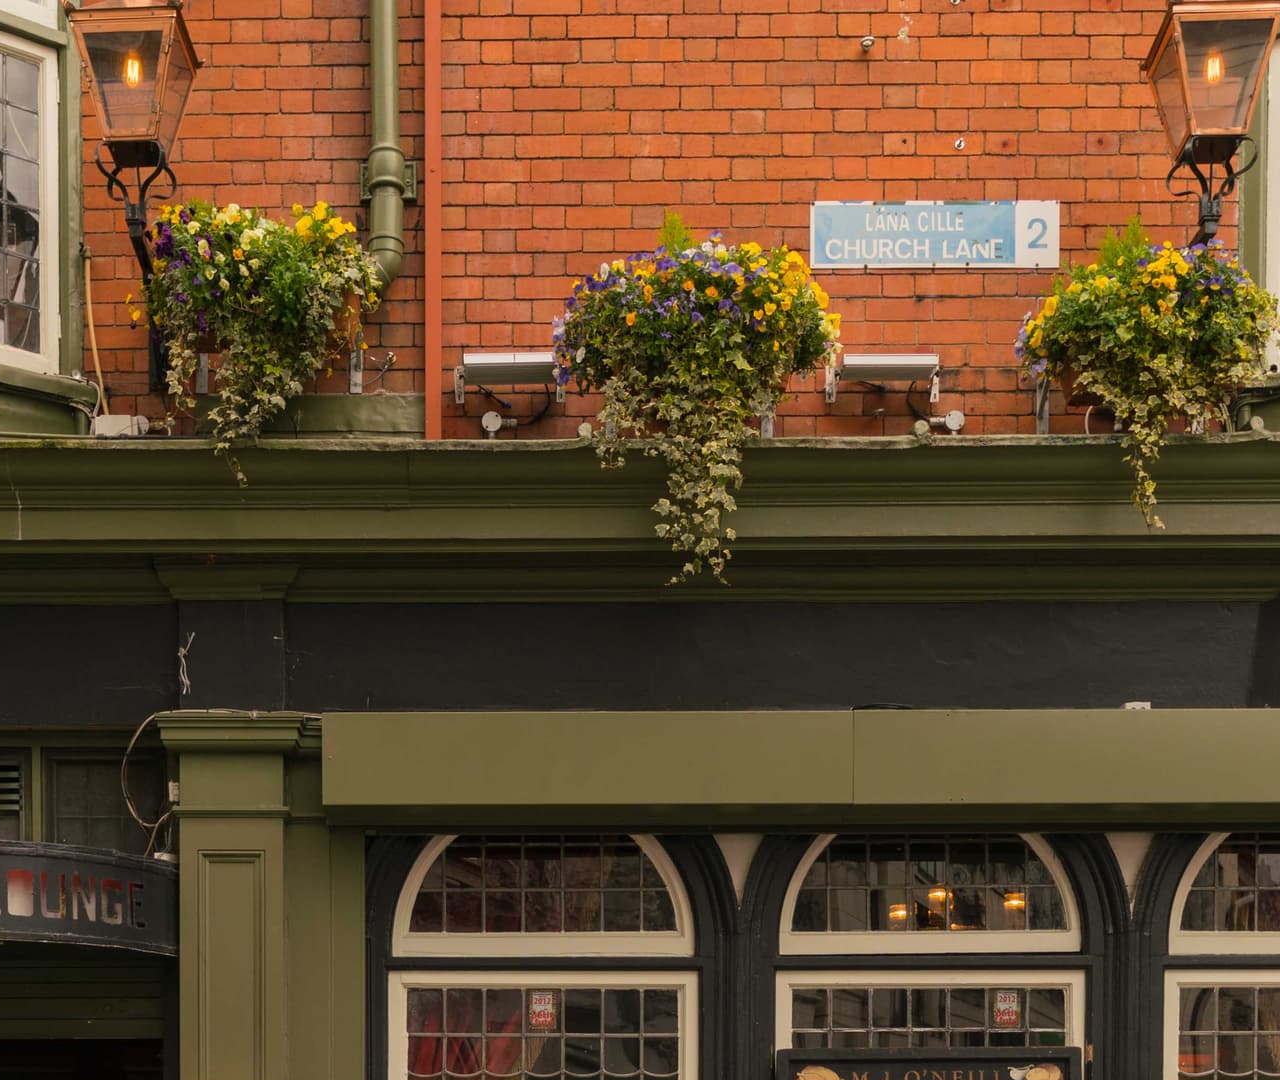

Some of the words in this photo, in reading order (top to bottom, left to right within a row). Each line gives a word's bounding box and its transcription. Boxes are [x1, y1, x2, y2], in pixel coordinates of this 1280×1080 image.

[918, 211, 965, 232] CILLE
[1026, 217, 1048, 249] 2
[825, 239, 930, 260] CHURCH
[942, 239, 1003, 260] LANE
